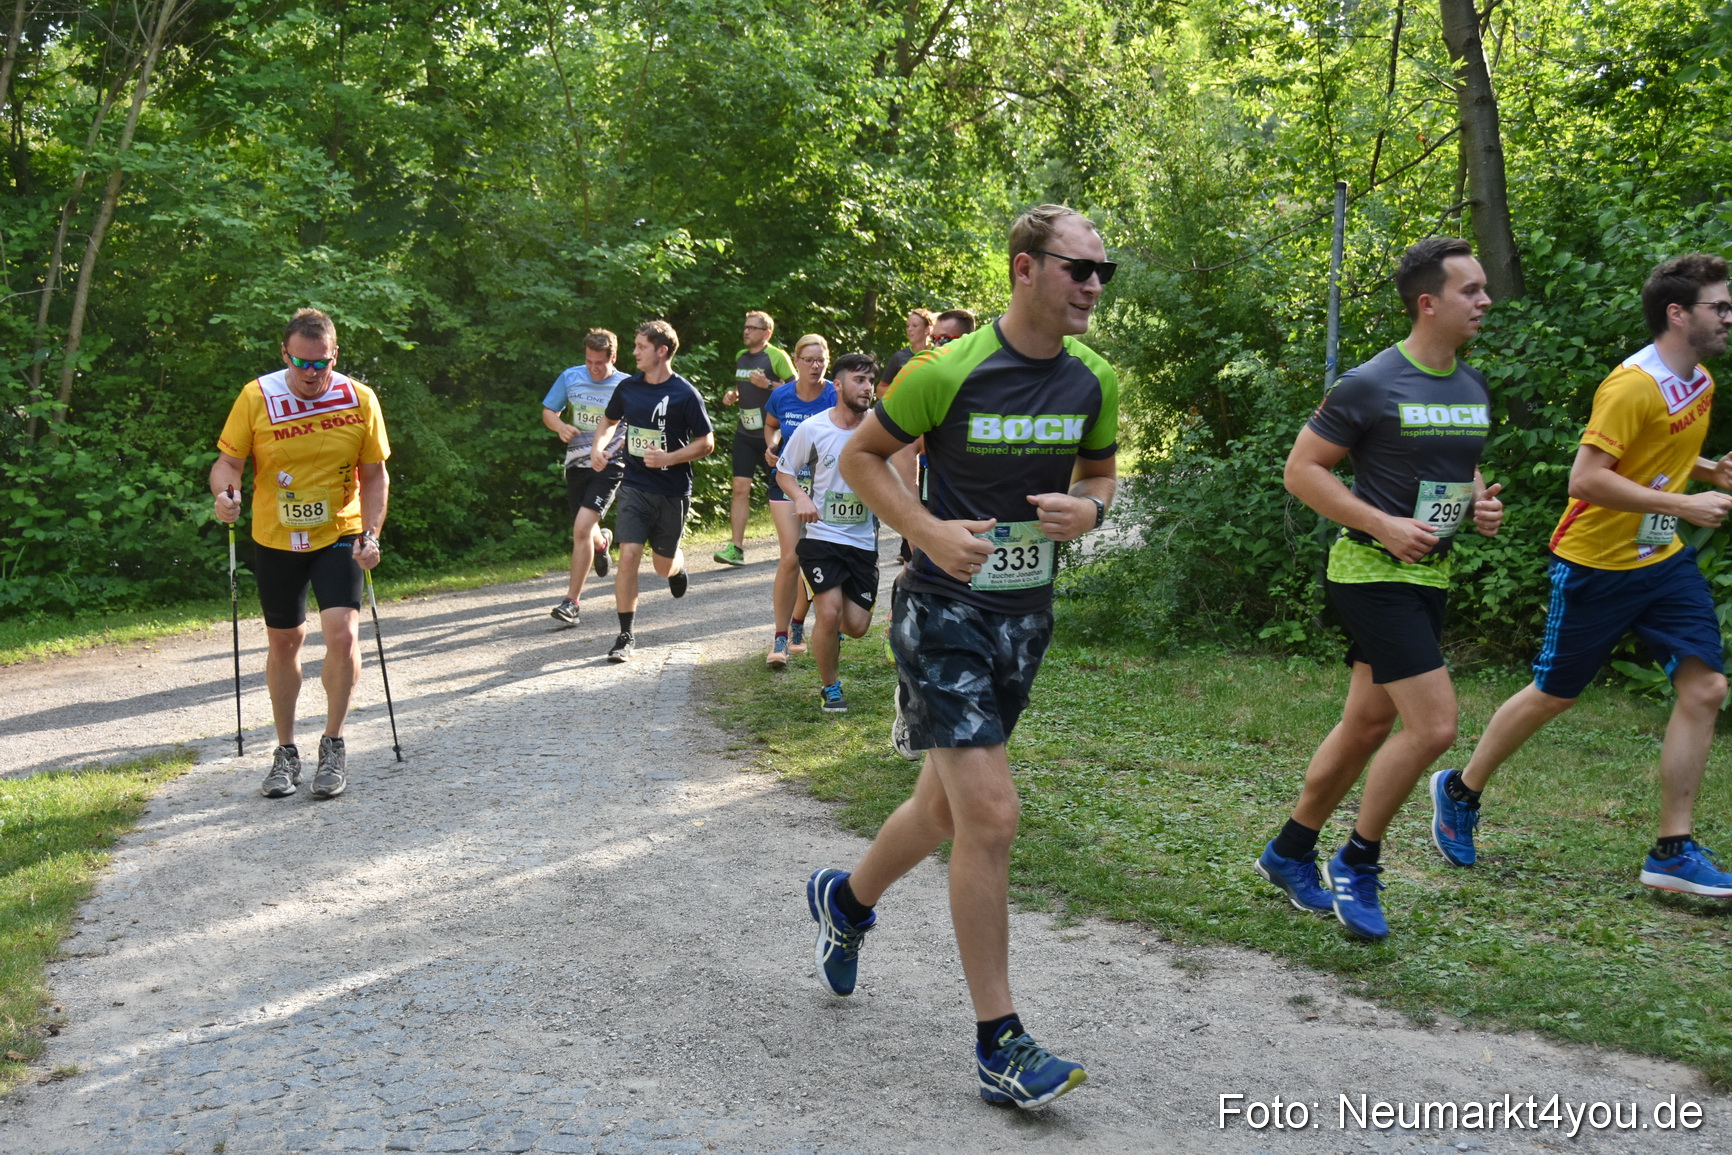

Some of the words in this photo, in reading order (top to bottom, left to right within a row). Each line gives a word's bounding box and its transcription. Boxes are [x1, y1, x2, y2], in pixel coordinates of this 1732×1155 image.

[577, 412, 602, 425] 1946
[1403, 407, 1489, 425] BOCK
[1670, 410, 1696, 435] MAX
[273, 423, 316, 441] MAX
[319, 413, 364, 431] BÖGL
[970, 416, 1084, 441] BOCK
[1400, 429, 1435, 438] inspired
[1435, 429, 1445, 437] by
[966, 444, 1009, 456] inspired
[1011, 446, 1022, 456] by
[1025, 447, 1053, 455] smart
[283, 502, 324, 518] 1588
[830, 503, 864, 516] 1010
[1428, 503, 1462, 522] 299
[993, 545, 1039, 572] 333
[812, 566, 824, 584] 3
[1016, 569, 1043, 577] Jonathan
